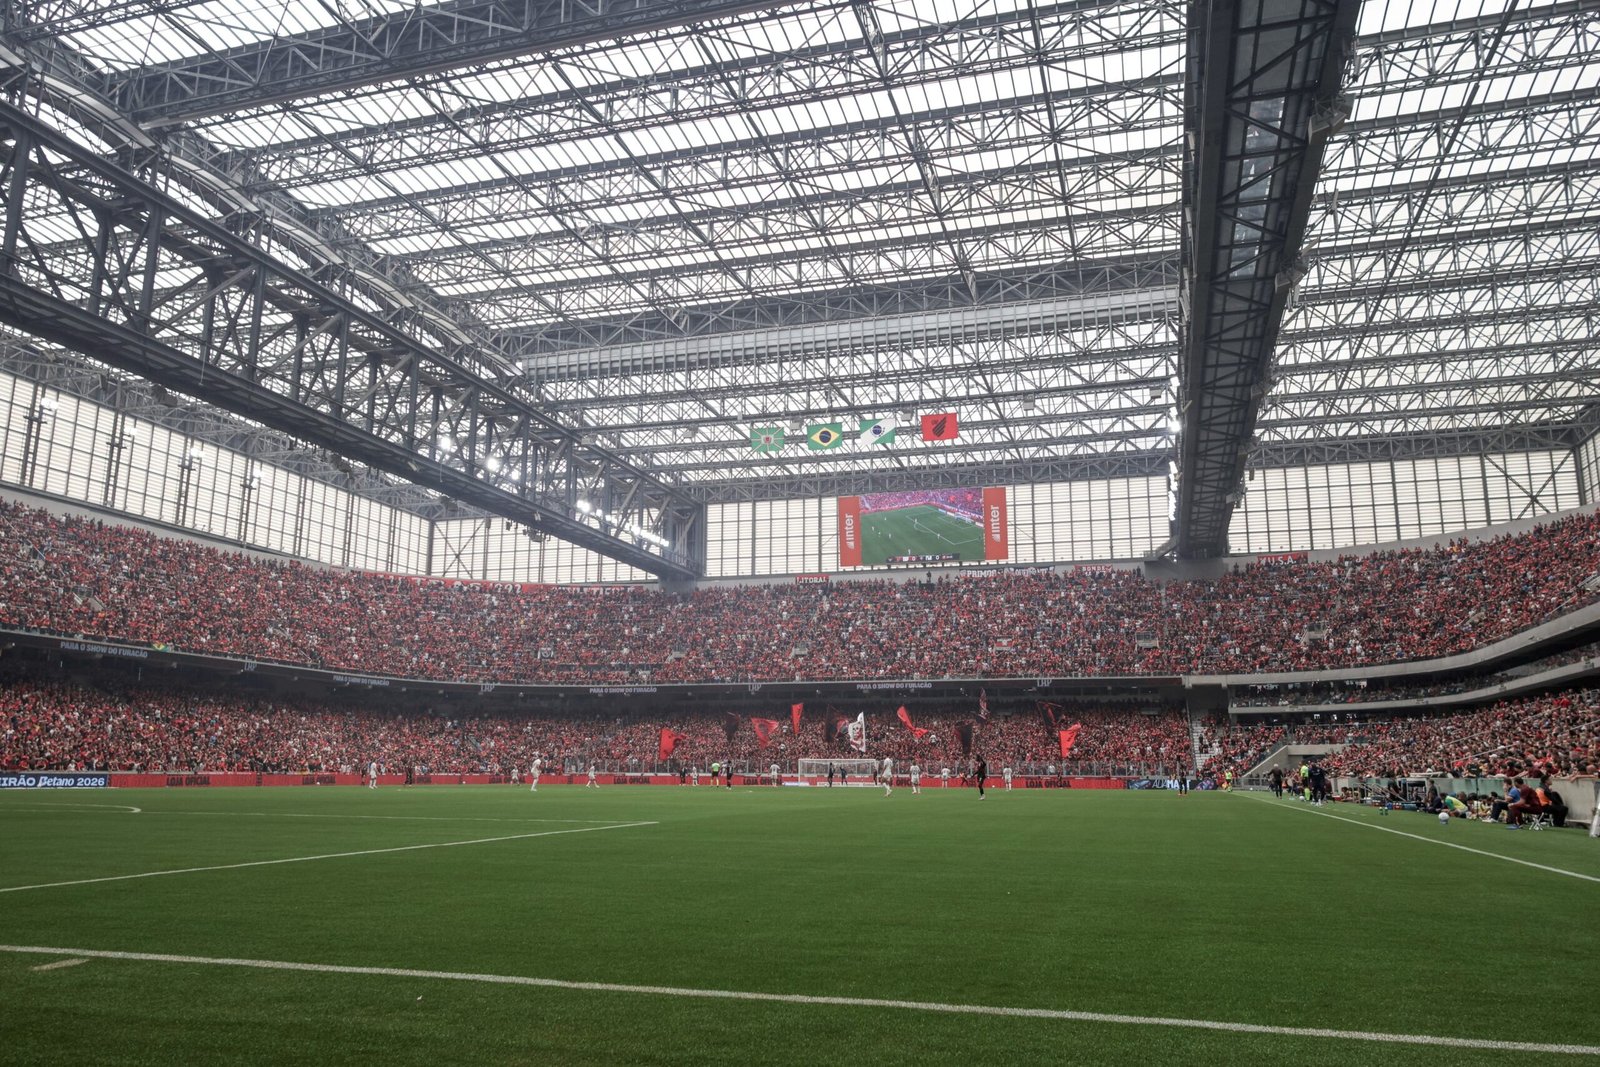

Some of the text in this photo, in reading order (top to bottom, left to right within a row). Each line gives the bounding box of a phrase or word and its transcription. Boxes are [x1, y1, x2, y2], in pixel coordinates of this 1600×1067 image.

[844, 513, 854, 541] inter
[991, 505, 1000, 533] inter
[796, 576, 826, 584] LITORAL
[60, 642, 78, 650] PARA
[86, 644, 107, 654] SHOW
[118, 648, 148, 658] FURACÃO
[37, 776, 74, 787] Betano
[77, 778, 105, 786] 2026
